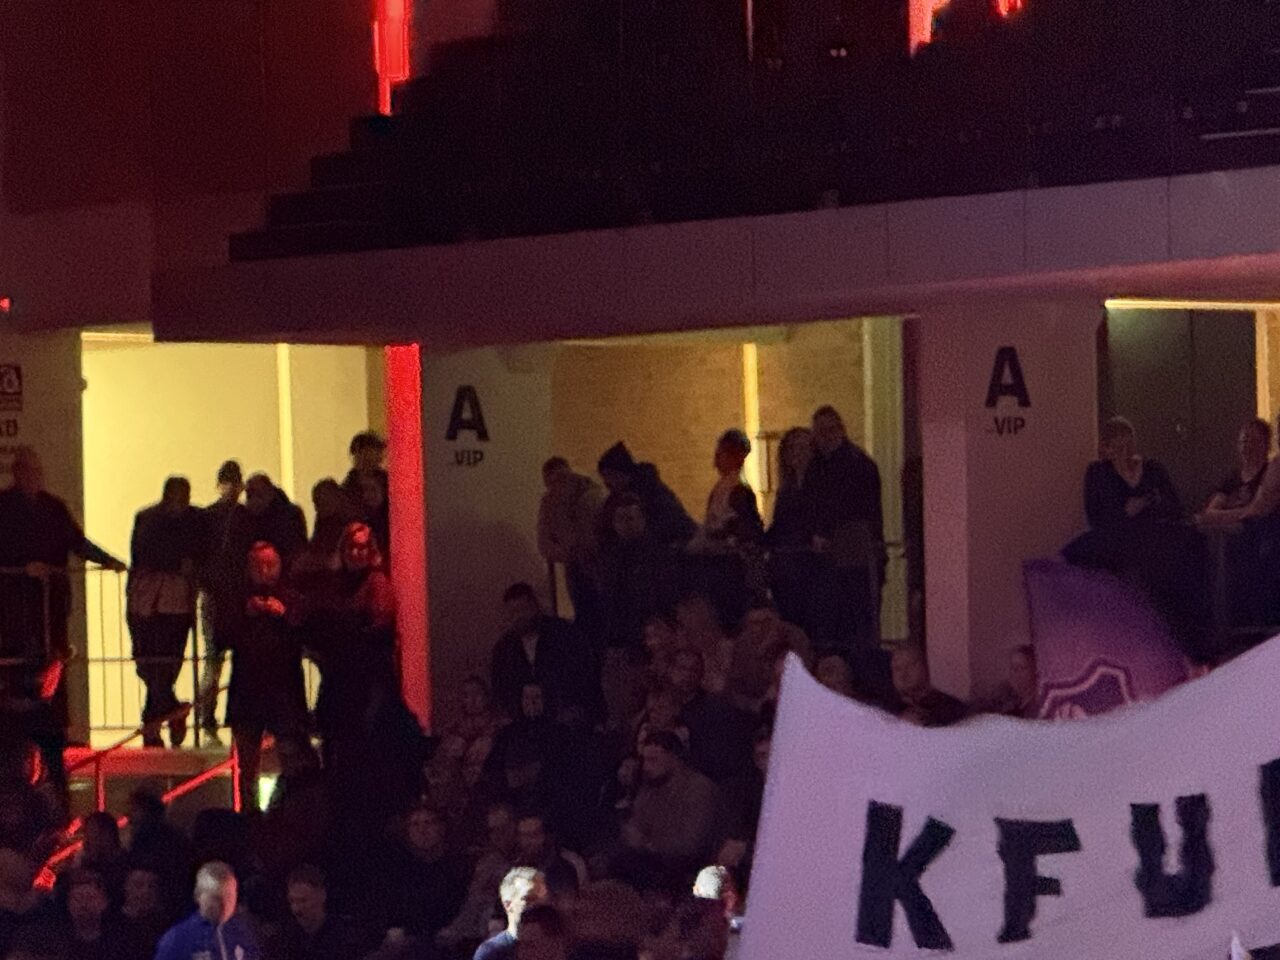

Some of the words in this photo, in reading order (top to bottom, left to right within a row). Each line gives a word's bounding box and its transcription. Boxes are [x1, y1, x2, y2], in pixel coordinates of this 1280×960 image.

[985, 346, 1032, 408] A
[445, 384, 490, 441] A
[993, 416, 1026, 436] VIP
[455, 450, 484, 467] VIP
